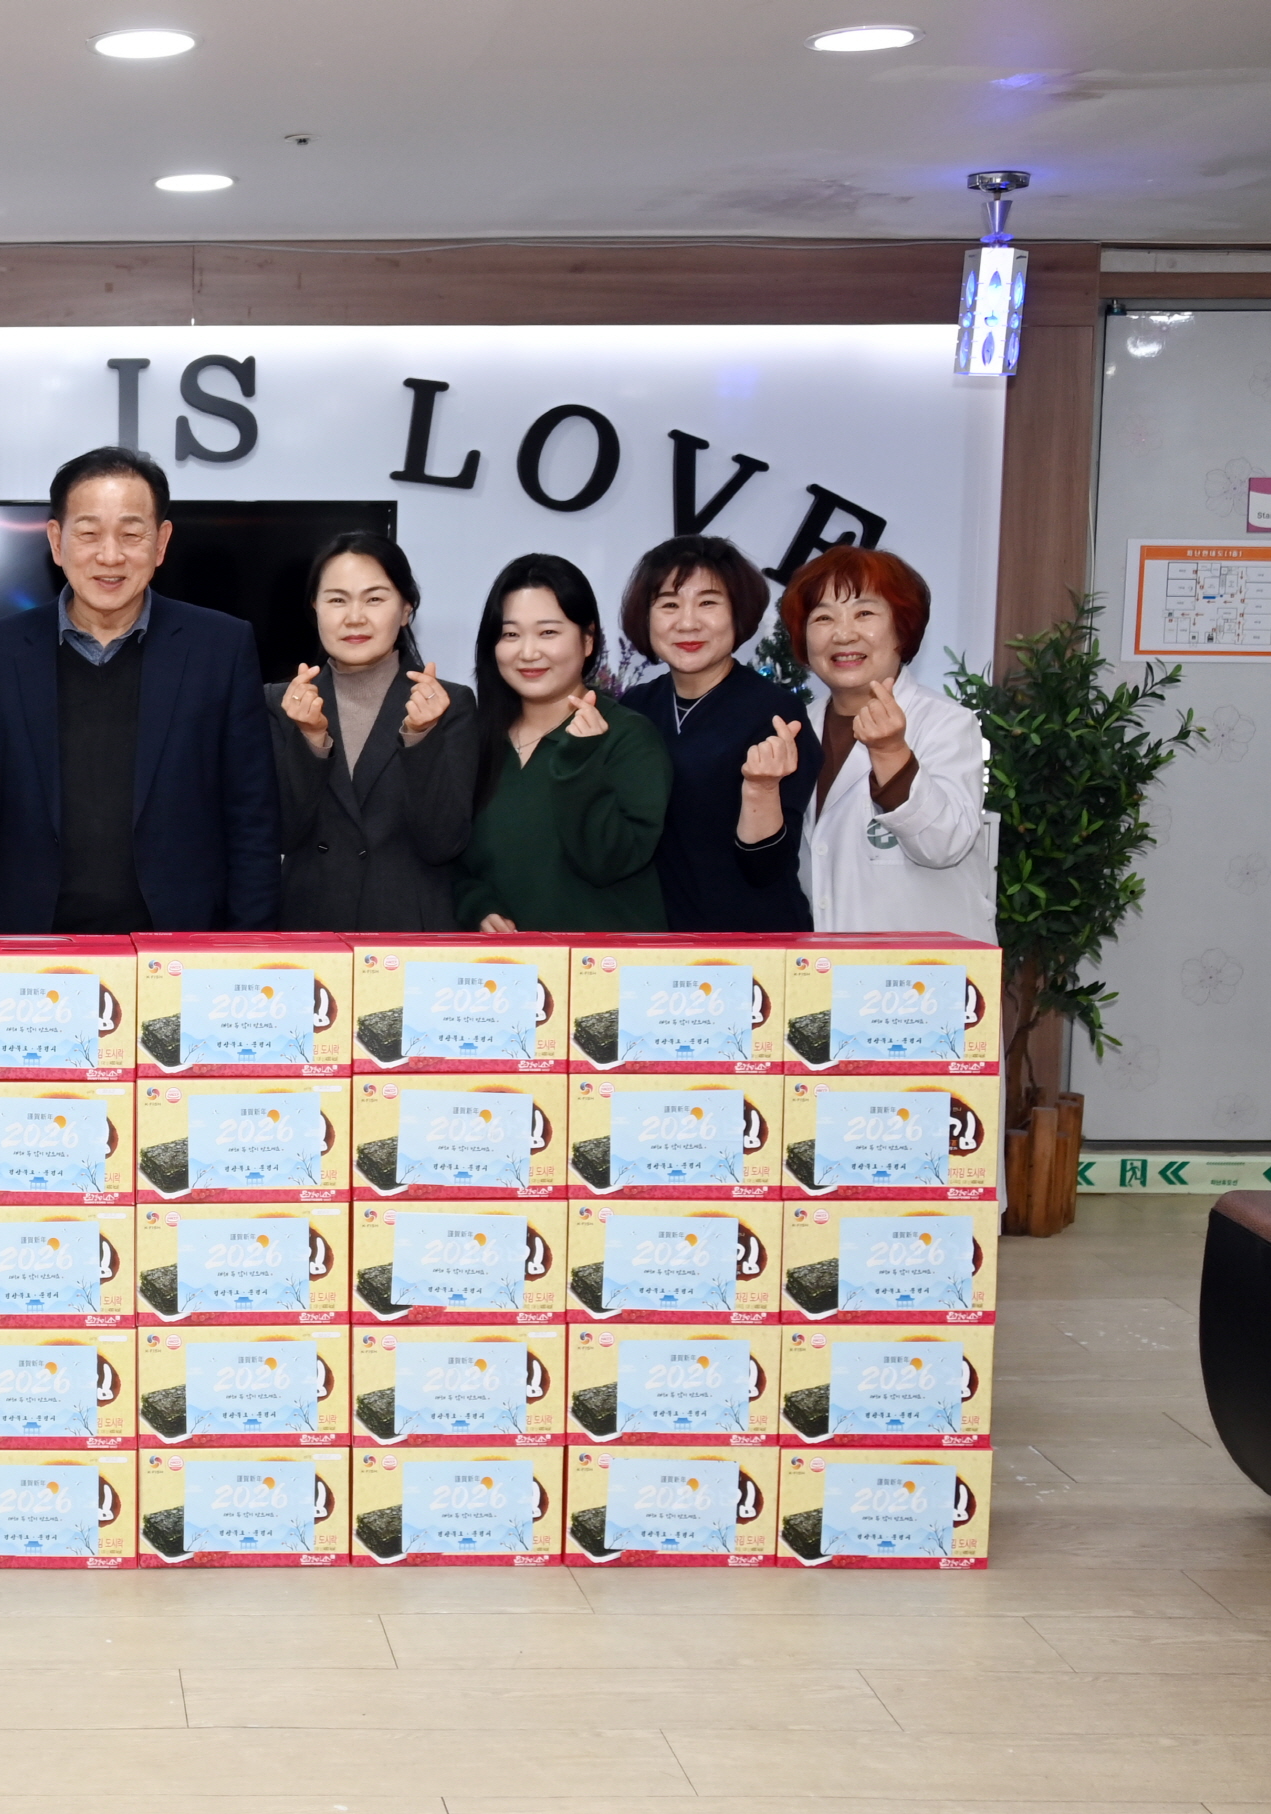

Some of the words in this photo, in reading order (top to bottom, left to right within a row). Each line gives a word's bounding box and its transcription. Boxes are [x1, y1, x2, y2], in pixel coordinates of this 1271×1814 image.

[107, 354, 258, 463] IS
[1257, 511, 1271, 520] Sta
[458, 977, 484, 986] 謹賀新年
[673, 981, 699, 989] 謹賀新年
[886, 980, 912, 988] 謹賀新年
[20, 988, 46, 997] 謹賀新年
[235, 984, 261, 992] 謹賀新年
[431, 984, 510, 1017] 2026
[647, 988, 725, 1018] 2026
[859, 987, 939, 1017] 2026
[209, 991, 287, 1022] 2026
[241, 1108, 267, 1116] 謹賀新年
[453, 1107, 480, 1116] 謹賀新年
[664, 1106, 691, 1114] 謹賀新年
[870, 1106, 897, 1115] 謹賀新年
[27, 1113, 54, 1121] 謹賀新年
[215, 1115, 294, 1145] 2026
[426, 1113, 505, 1146] 2026
[638, 1113, 717, 1142] 2026
[844, 1113, 923, 1144] 2026
[1, 1119, 80, 1151] 2026
[230, 1233, 256, 1241] 謹賀新年
[448, 1230, 474, 1239] 謹賀新年
[658, 1231, 685, 1240] 謹賀新年
[893, 1231, 919, 1239] 謹賀新年
[21, 1236, 47, 1244] 謹賀新年
[205, 1240, 283, 1270] 2026
[421, 1236, 500, 1269] 2026
[632, 1237, 711, 1269] 2026
[867, 1239, 945, 1268] 2026
[238, 1356, 265, 1364] 謹賀新年
[448, 1357, 474, 1365] 謹賀新年
[671, 1354, 697, 1362] 謹賀新年
[884, 1356, 910, 1364] 謹賀新年
[19, 1360, 45, 1368] 謹賀新年
[213, 1363, 291, 1392] 2026
[423, 1364, 500, 1394] 2026
[645, 1361, 723, 1391] 2026
[858, 1363, 936, 1393] 2026
[21, 1479, 47, 1487] 謹賀新年
[237, 1475, 263, 1483] 謹賀新年
[455, 1475, 481, 1483] 謹賀新年
[661, 1475, 687, 1484] 謹賀新年
[877, 1478, 903, 1487] 謹賀新年
[211, 1482, 288, 1511] 2026
[430, 1483, 506, 1511] 2026
[634, 1481, 712, 1513] 2026
[850, 1485, 929, 1515] 2026
